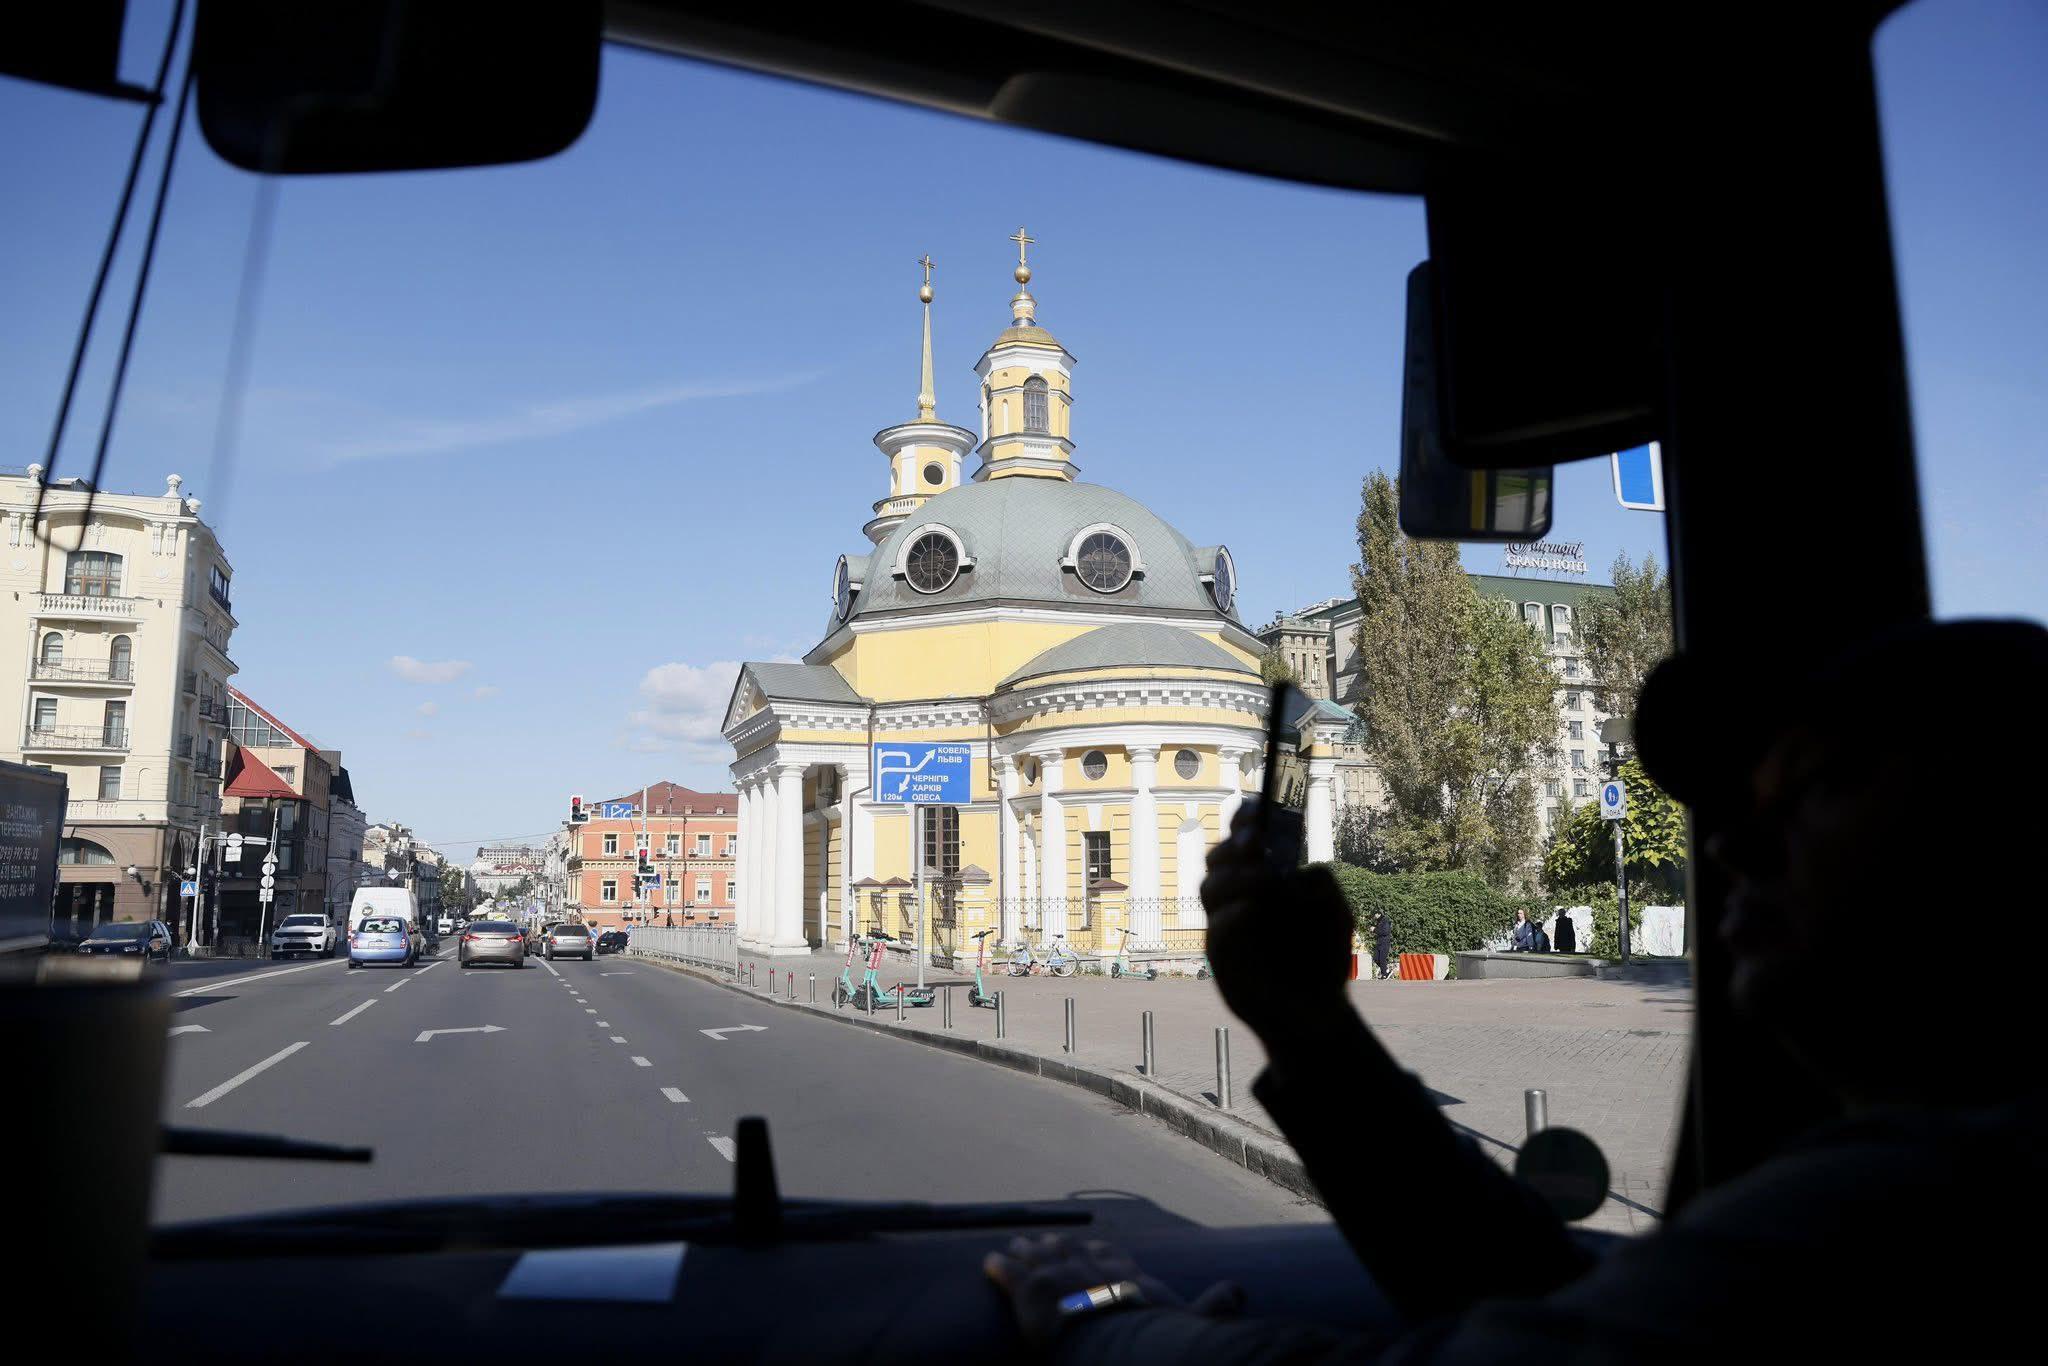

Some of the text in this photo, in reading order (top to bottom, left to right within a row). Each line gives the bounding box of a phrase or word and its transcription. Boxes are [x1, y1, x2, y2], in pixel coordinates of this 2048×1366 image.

[1507, 556, 1588, 572] GRAND HOTEL
[911, 793, 941, 801] ОДЕСА
